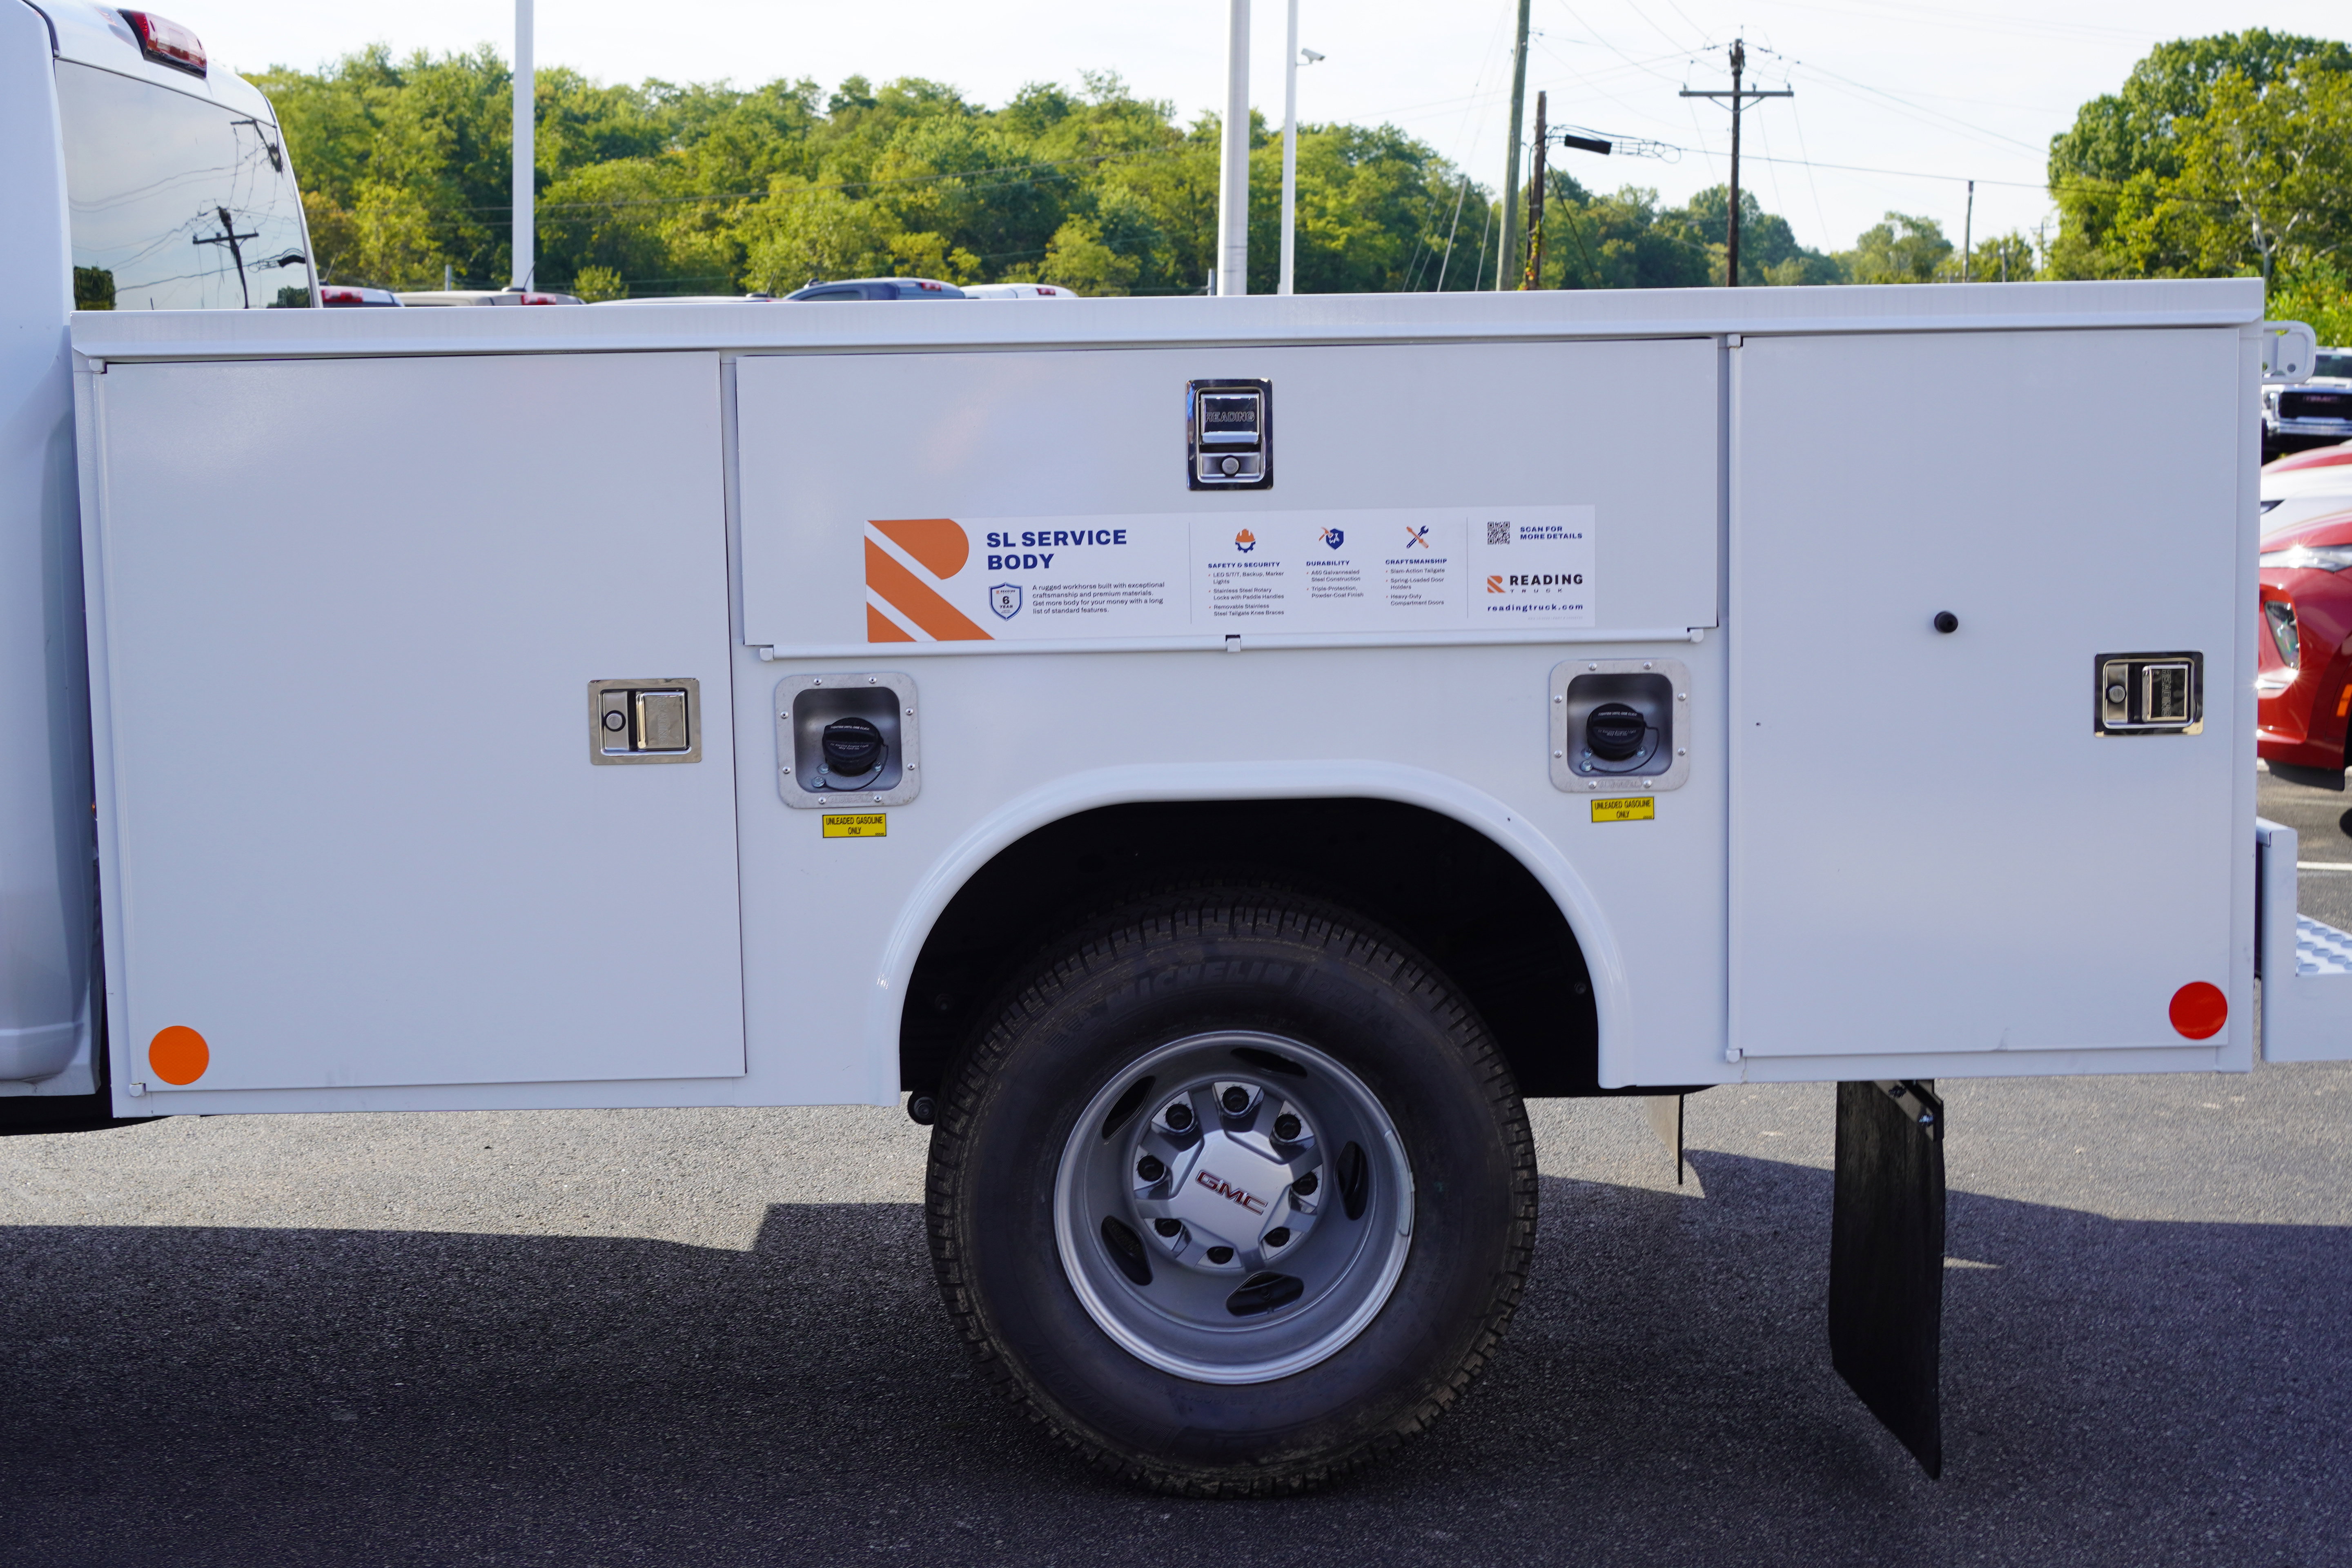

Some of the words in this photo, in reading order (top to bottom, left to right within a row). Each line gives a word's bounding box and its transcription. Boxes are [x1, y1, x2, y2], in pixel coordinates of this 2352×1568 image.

[1206, 411, 1255, 422] READING
[987, 532, 1016, 547] SL
[1022, 529, 1127, 546] SERVICE
[988, 553, 1054, 570] BODY
[1510, 574, 1583, 586] READING
[1002, 596, 1009, 604] 6
[1487, 603, 1583, 612] readingtruck.com
[1595, 800, 1622, 810] UNLEADED
[1624, 799, 1651, 808] GASOLINE
[826, 817, 854, 825] UNLEADED
[856, 816, 883, 824] GASOLINE
[1616, 811, 1630, 819] ONLY
[1195, 1169, 1268, 1216] GMC
